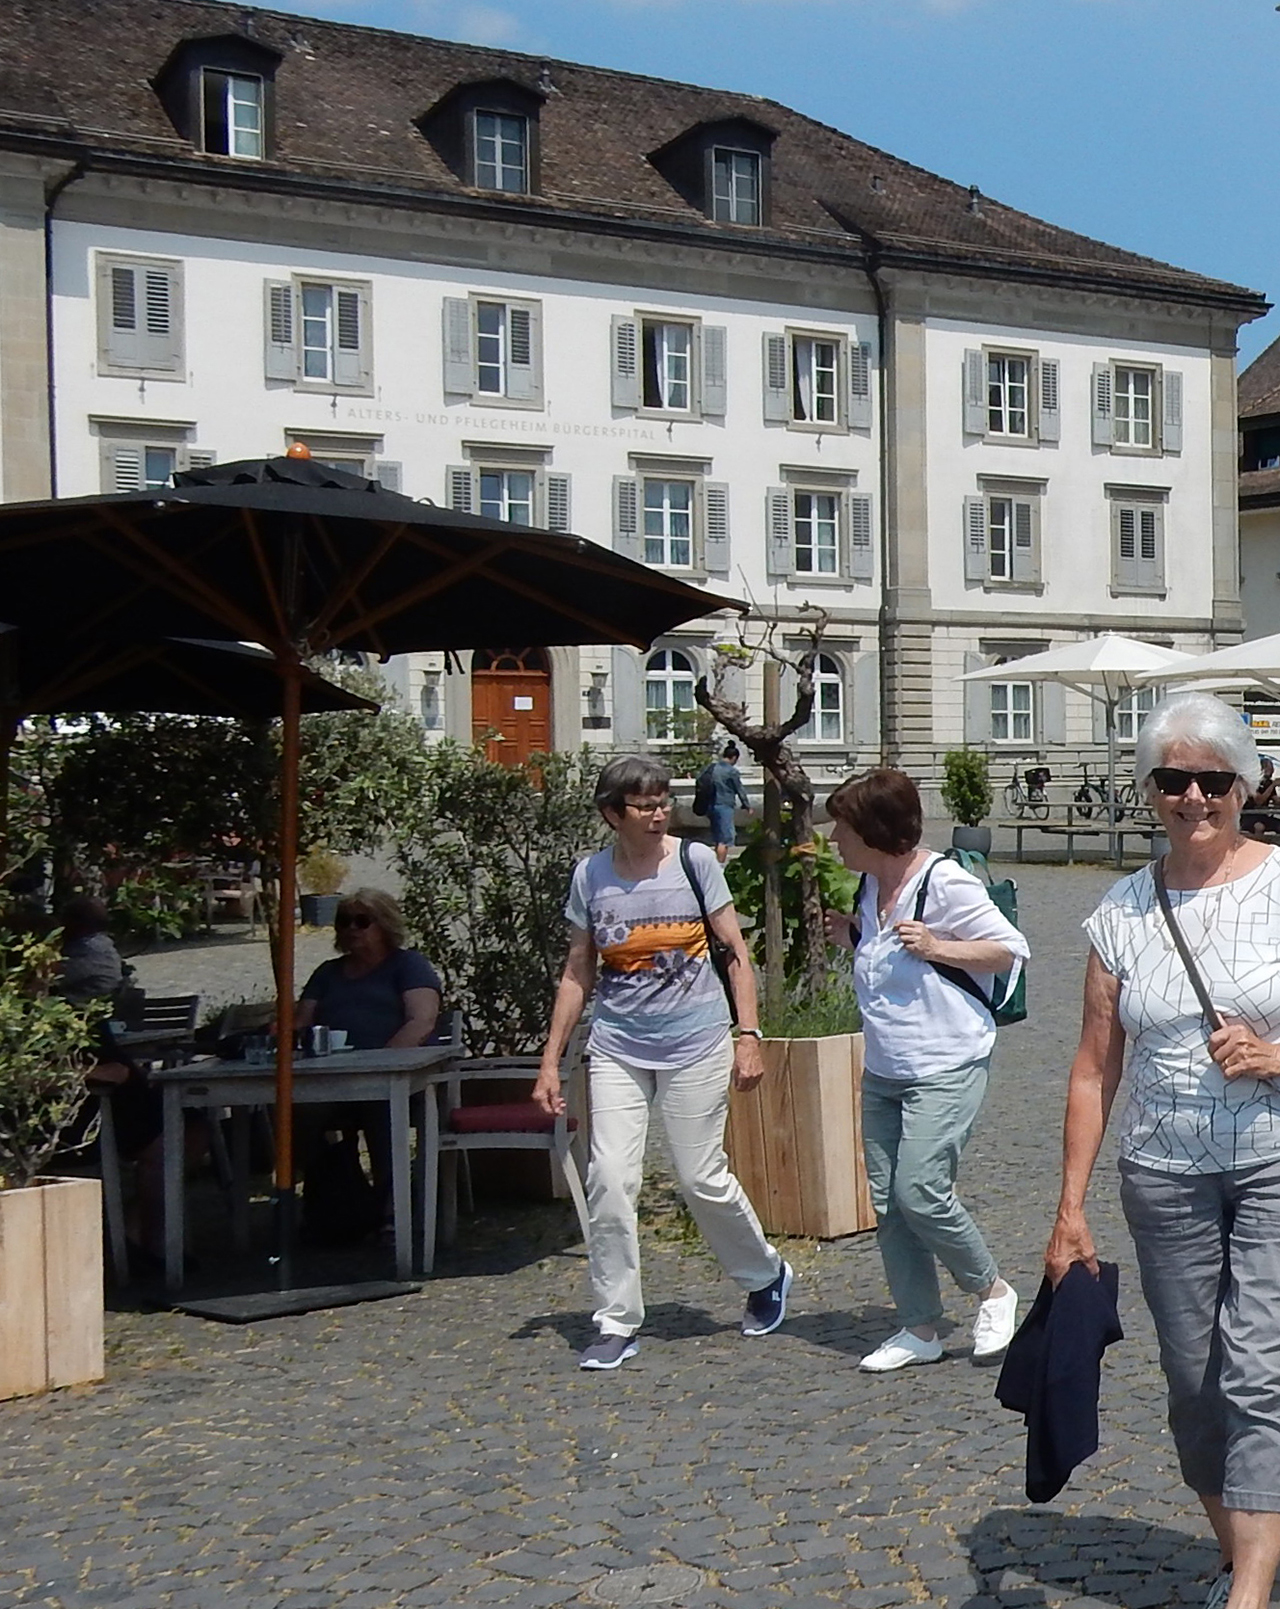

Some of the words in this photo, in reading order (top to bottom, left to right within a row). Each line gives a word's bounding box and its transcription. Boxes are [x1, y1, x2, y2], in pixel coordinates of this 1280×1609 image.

[348, 408, 408, 422] ALTERS-
[416, 413, 449, 425] UND
[455, 415, 547, 432] PFLEGEHEIM
[553, 422, 655, 440] BÜRGERSPITAL
